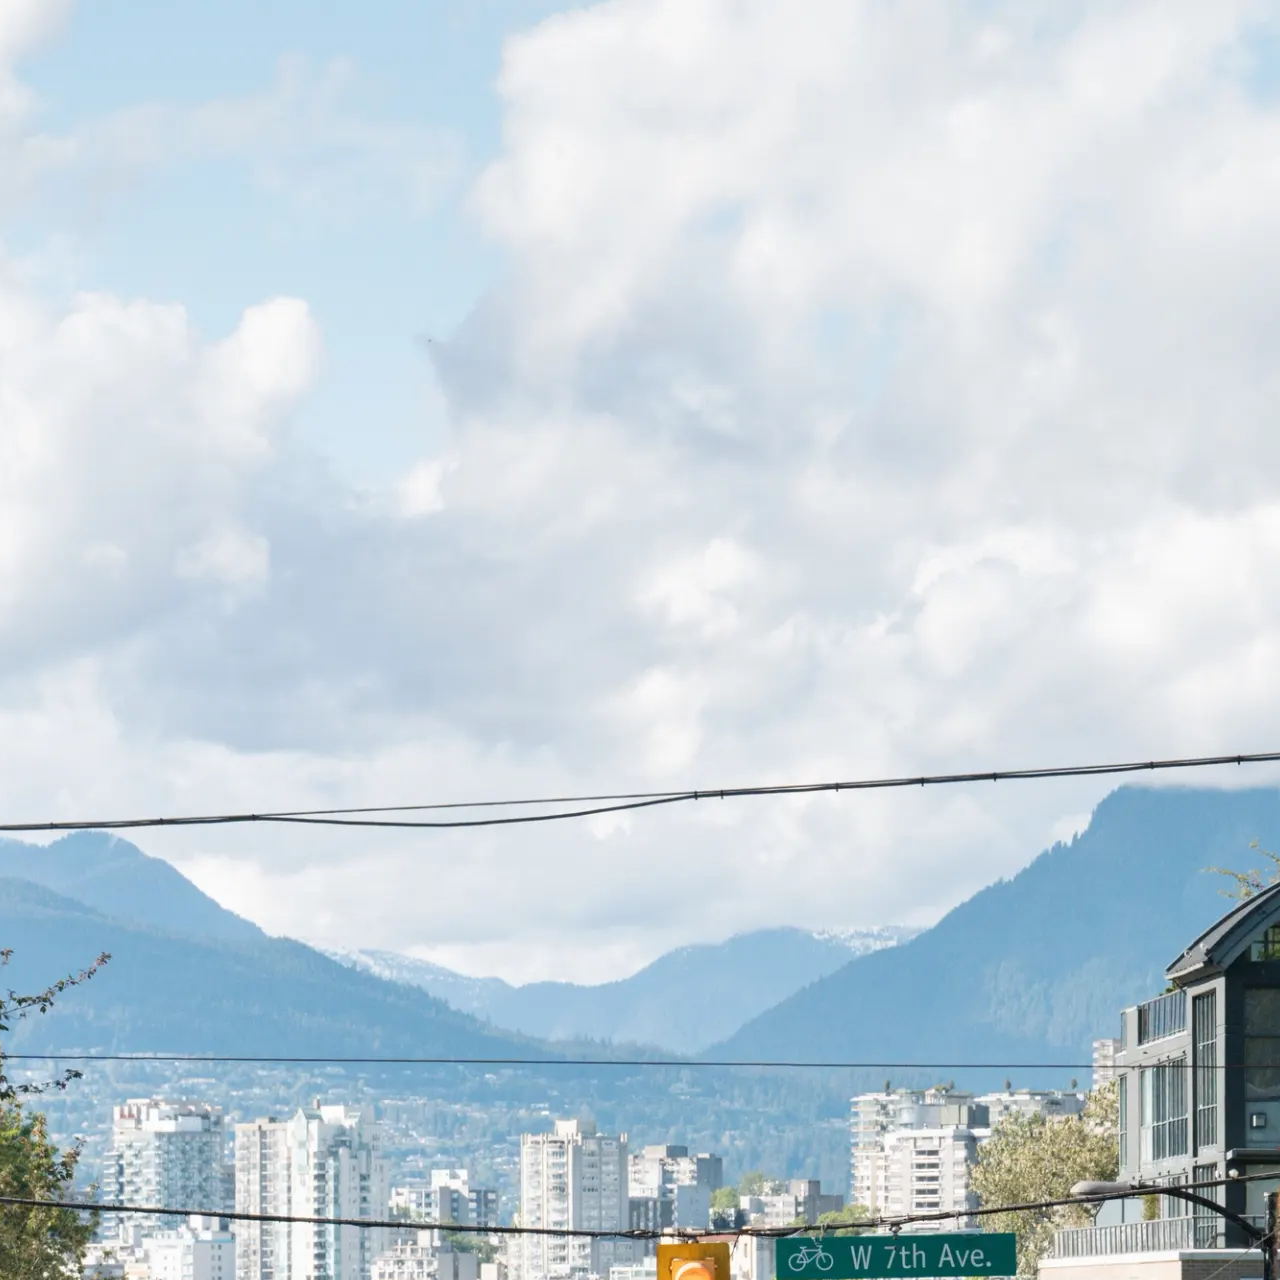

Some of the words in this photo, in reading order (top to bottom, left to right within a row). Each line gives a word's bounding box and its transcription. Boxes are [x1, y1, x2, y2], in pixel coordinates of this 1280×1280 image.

[850, 1244, 872, 1270] W
[884, 1243, 926, 1269] 7th
[938, 1243, 992, 1268] Ave.
